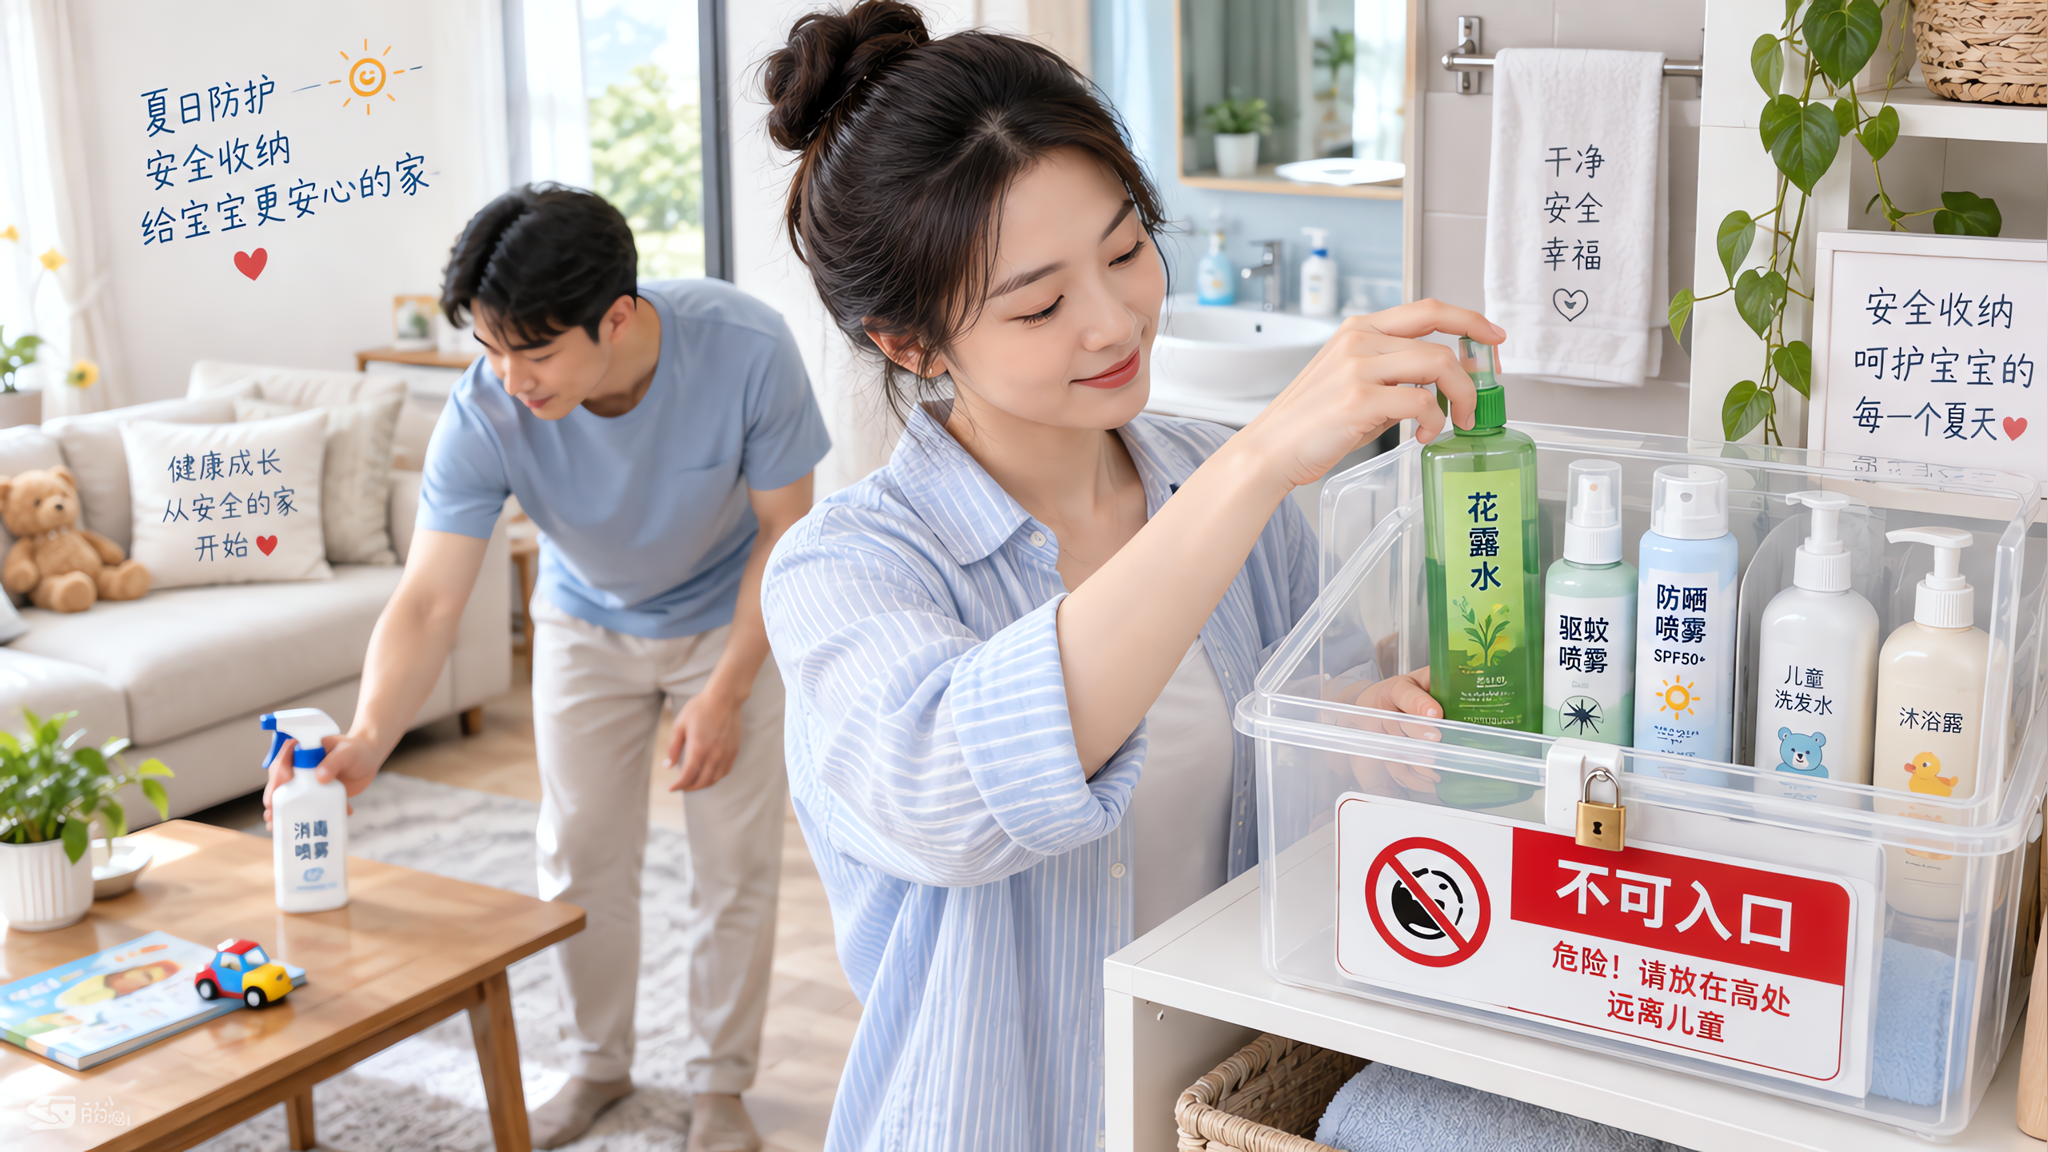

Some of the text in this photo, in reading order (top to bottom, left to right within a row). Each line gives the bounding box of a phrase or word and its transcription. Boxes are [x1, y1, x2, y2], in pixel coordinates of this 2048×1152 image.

[141, 74, 275, 138] 夏日防护
[147, 130, 290, 191] 安全收纳
[1544, 143, 1605, 180] 干净
[141, 152, 430, 246] 给宝宝更安心的家
[1543, 190, 1603, 225] 安全
[1541, 236, 1602, 272] 幸福
[1865, 286, 2013, 329] 安全收纳
[1854, 345, 2034, 389] 呵护宝宝的
[1852, 395, 1998, 441] 每一个夏天
[167, 448, 282, 484] 健康成长
[162, 485, 298, 523] 从安全的家
[194, 531, 249, 562] 开始
[1467, 491, 1502, 592] 花露水
[1656, 583, 1708, 613] 防晒
[1559, 614, 1610, 644] 驱蚊
[1655, 614, 1707, 644] 喷雾
[1559, 645, 1609, 674] 喷雾
[1784, 664, 1825, 690] 儿童
[1774, 689, 1834, 716] 洗发水
[1899, 706, 1964, 734] 沐浴露
[1555, 858, 1793, 953] 不可入口
[1551, 939, 1792, 1018] 危险！请放在高处
[1606, 990, 1725, 1044] 远离儿童
